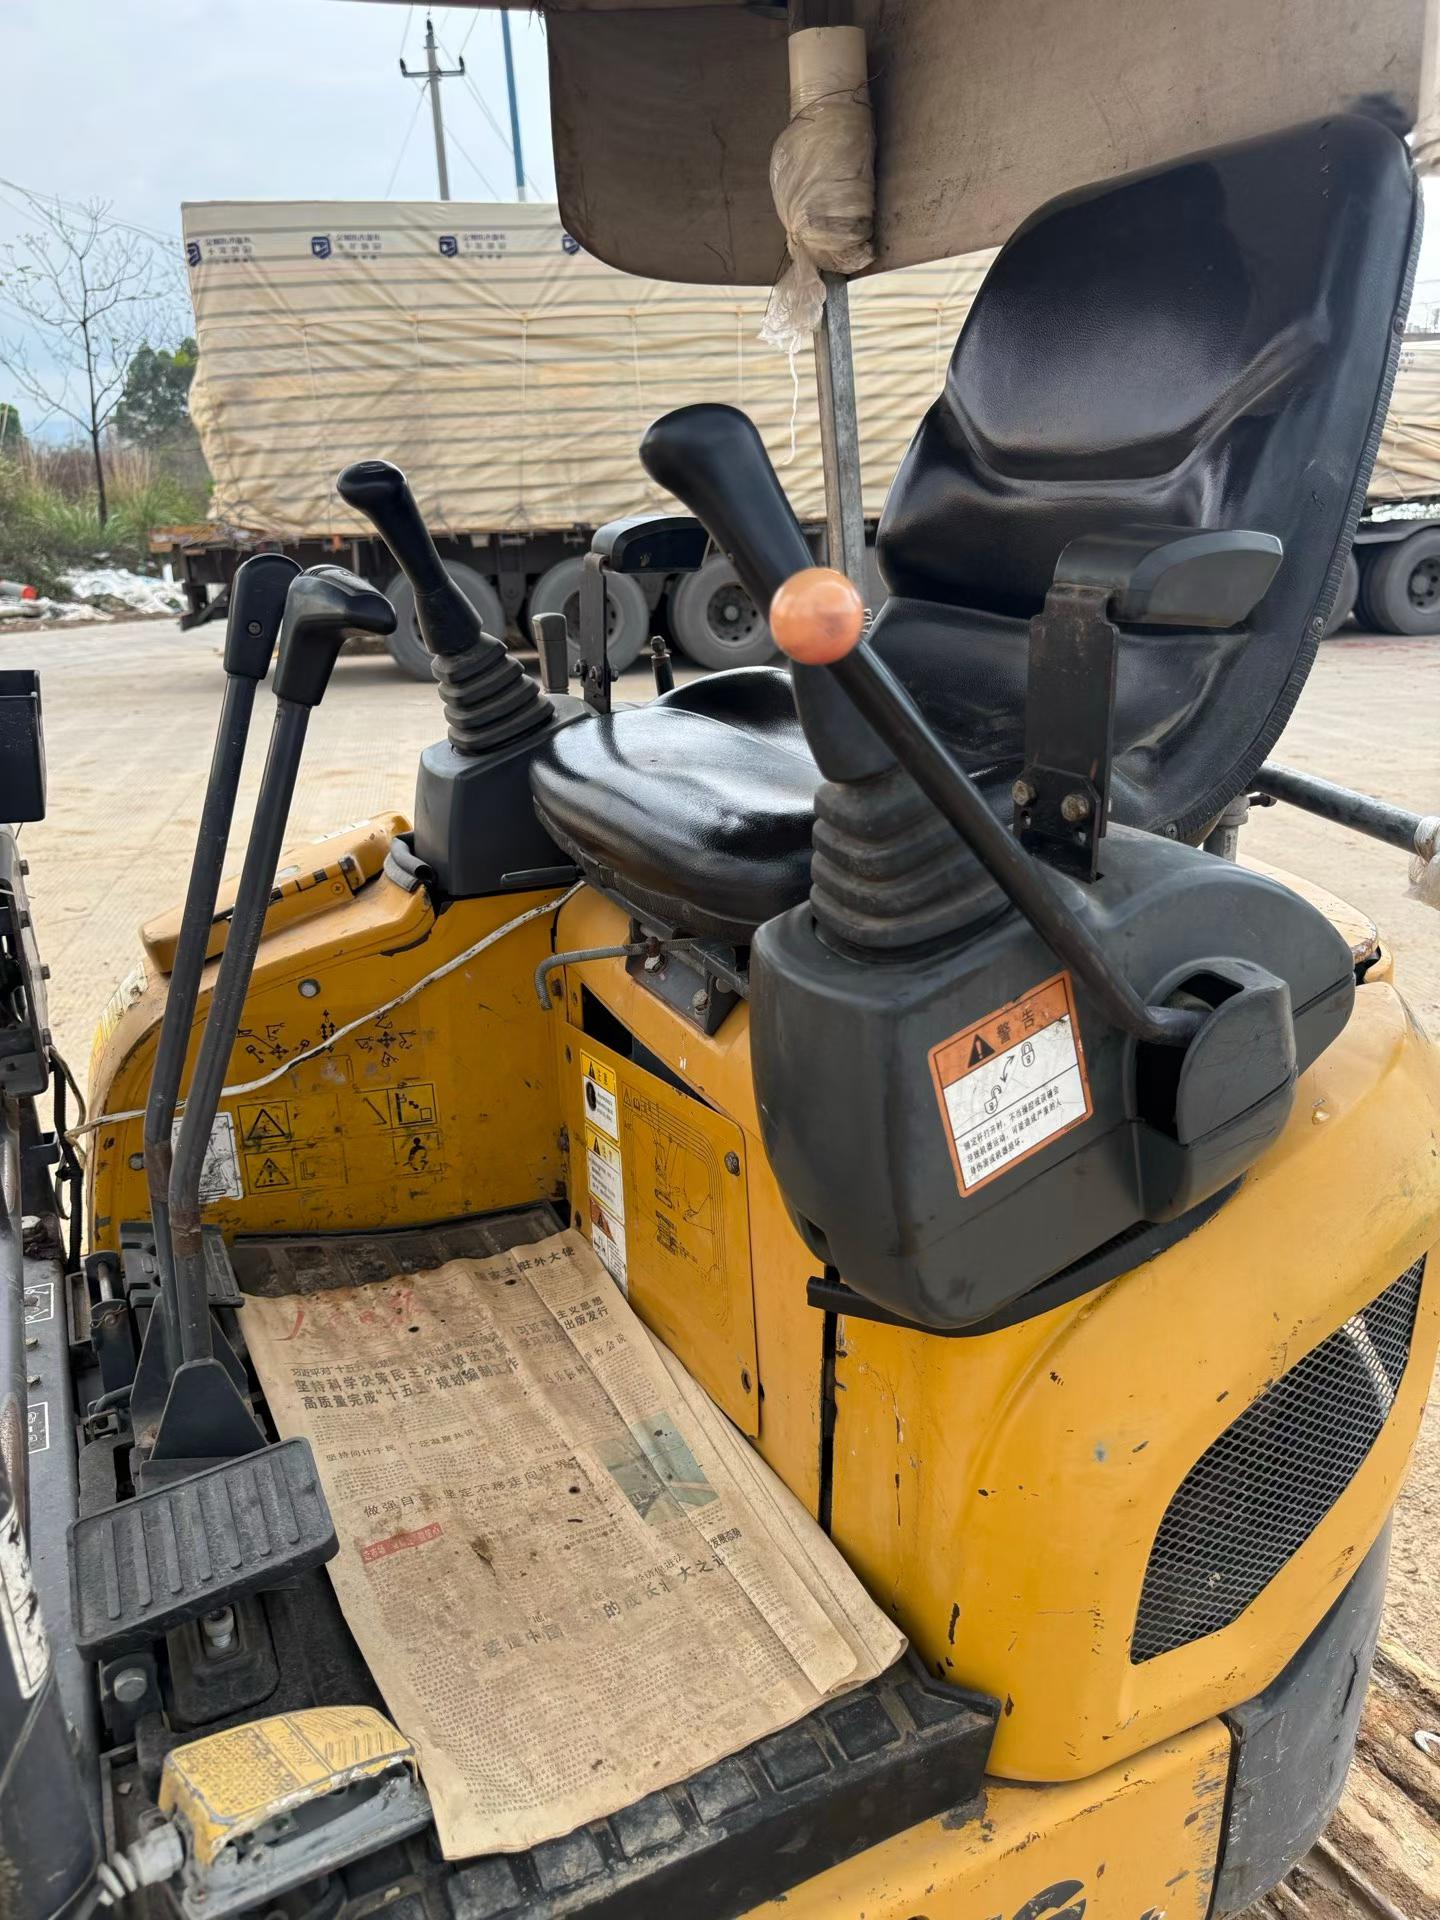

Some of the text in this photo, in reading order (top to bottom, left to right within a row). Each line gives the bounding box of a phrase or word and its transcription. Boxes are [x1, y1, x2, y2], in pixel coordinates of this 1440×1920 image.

[996, 1007, 1036, 1046] 警告
[556, 1295, 605, 1320] 主义思想
[563, 1305, 609, 1331] 出版发行
